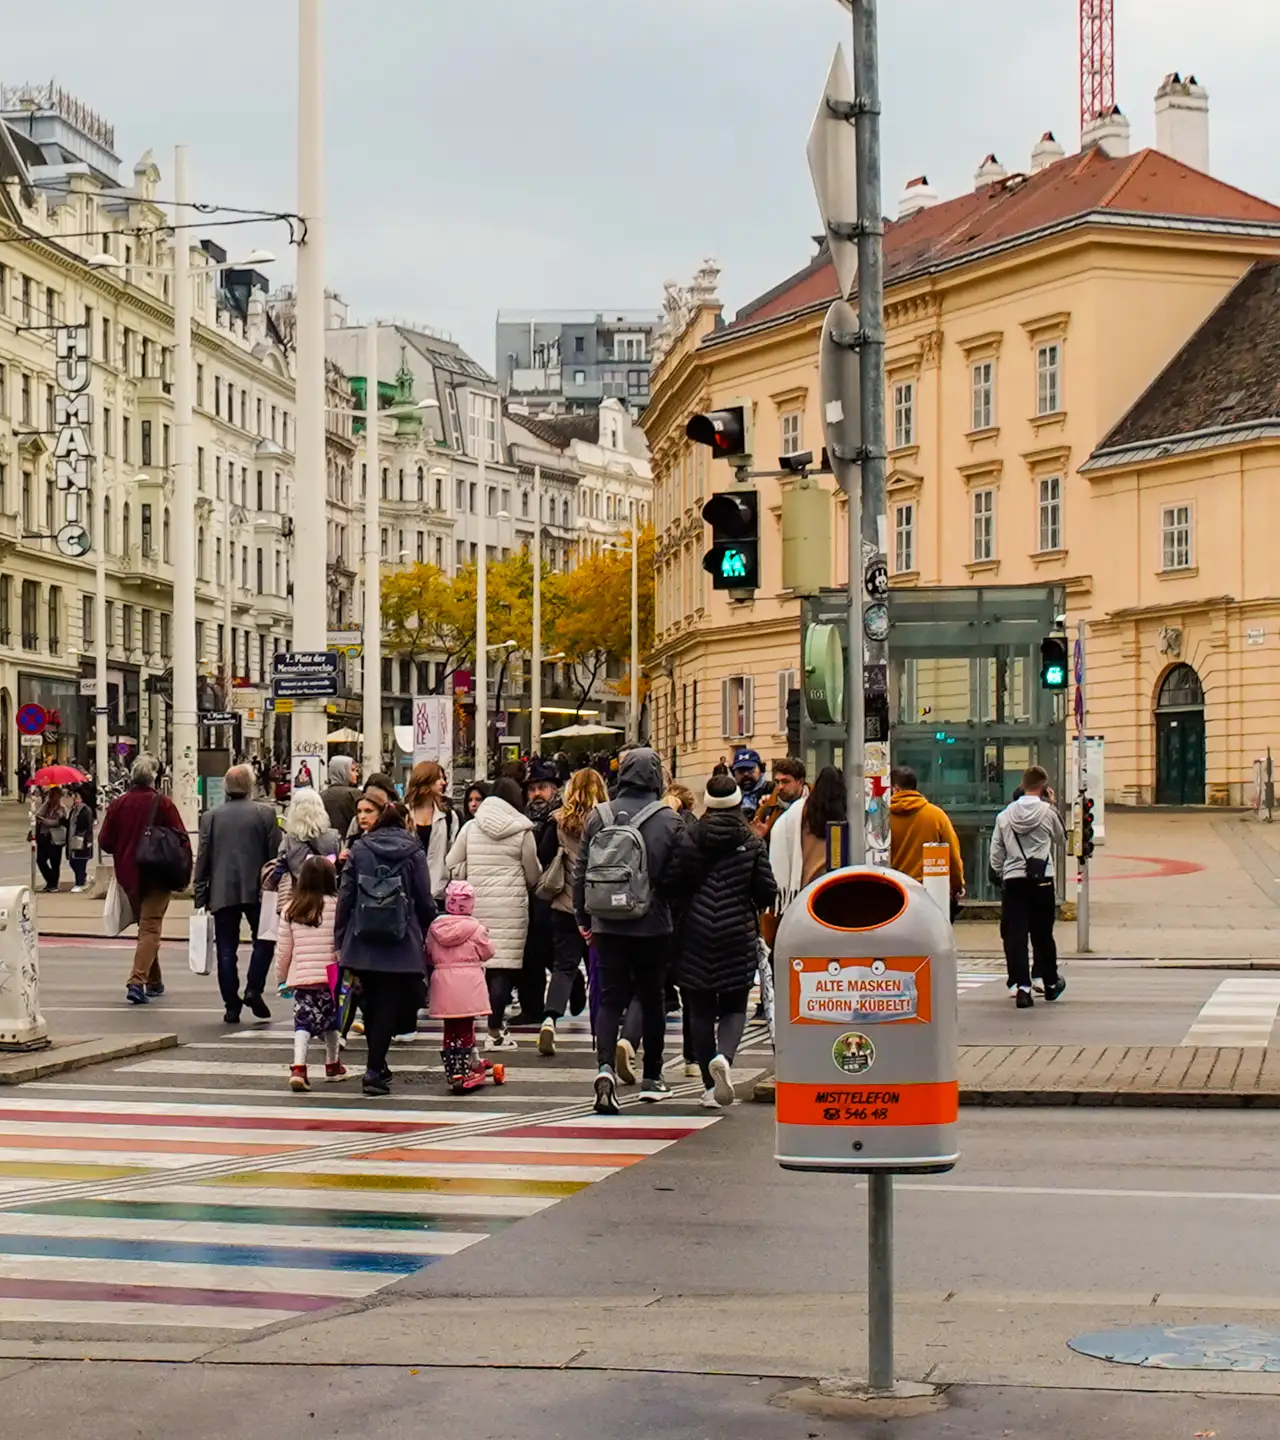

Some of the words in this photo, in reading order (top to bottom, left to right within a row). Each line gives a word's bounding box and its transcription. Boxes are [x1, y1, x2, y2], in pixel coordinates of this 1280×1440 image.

[54, 327, 90, 557] HUMANIC
[815, 980, 844, 992] ALTE
[847, 980, 901, 992] MASKEN
[807, 997, 852, 1012] G'HÖRN
[856, 997, 911, 1011] 'KÜBELT!
[815, 1092, 900, 1105] MISTTELEFON
[844, 1108, 868, 1120] 546
[871, 1108, 889, 1120] 48
